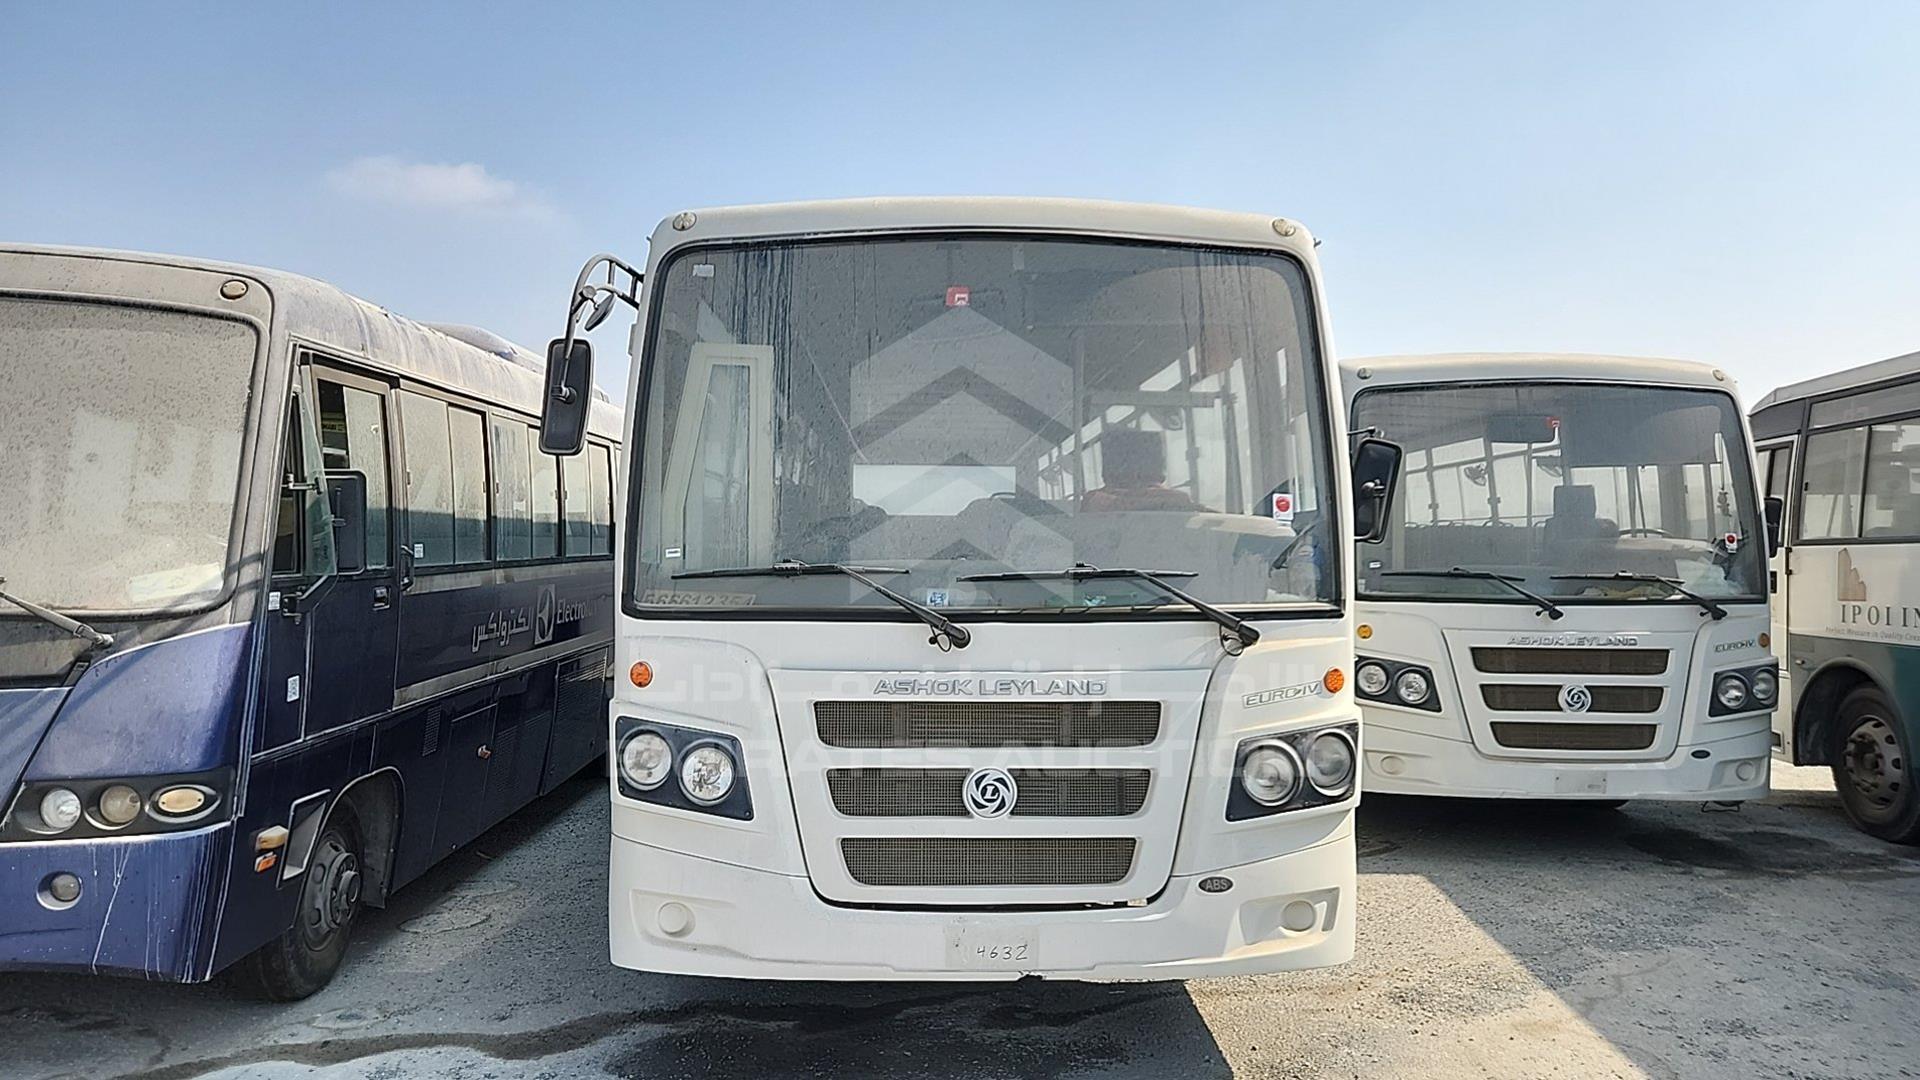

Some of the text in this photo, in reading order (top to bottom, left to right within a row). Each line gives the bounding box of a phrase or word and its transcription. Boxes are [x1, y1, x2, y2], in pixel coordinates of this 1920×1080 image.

[556, 599, 599, 624] Electro
[1507, 635, 1639, 647] ASHOK LEYLAND
[873, 679, 1107, 696] ASHOK LEYLAND
[1205, 879, 1229, 891] ABS
[976, 944, 1029, 961] 4632
